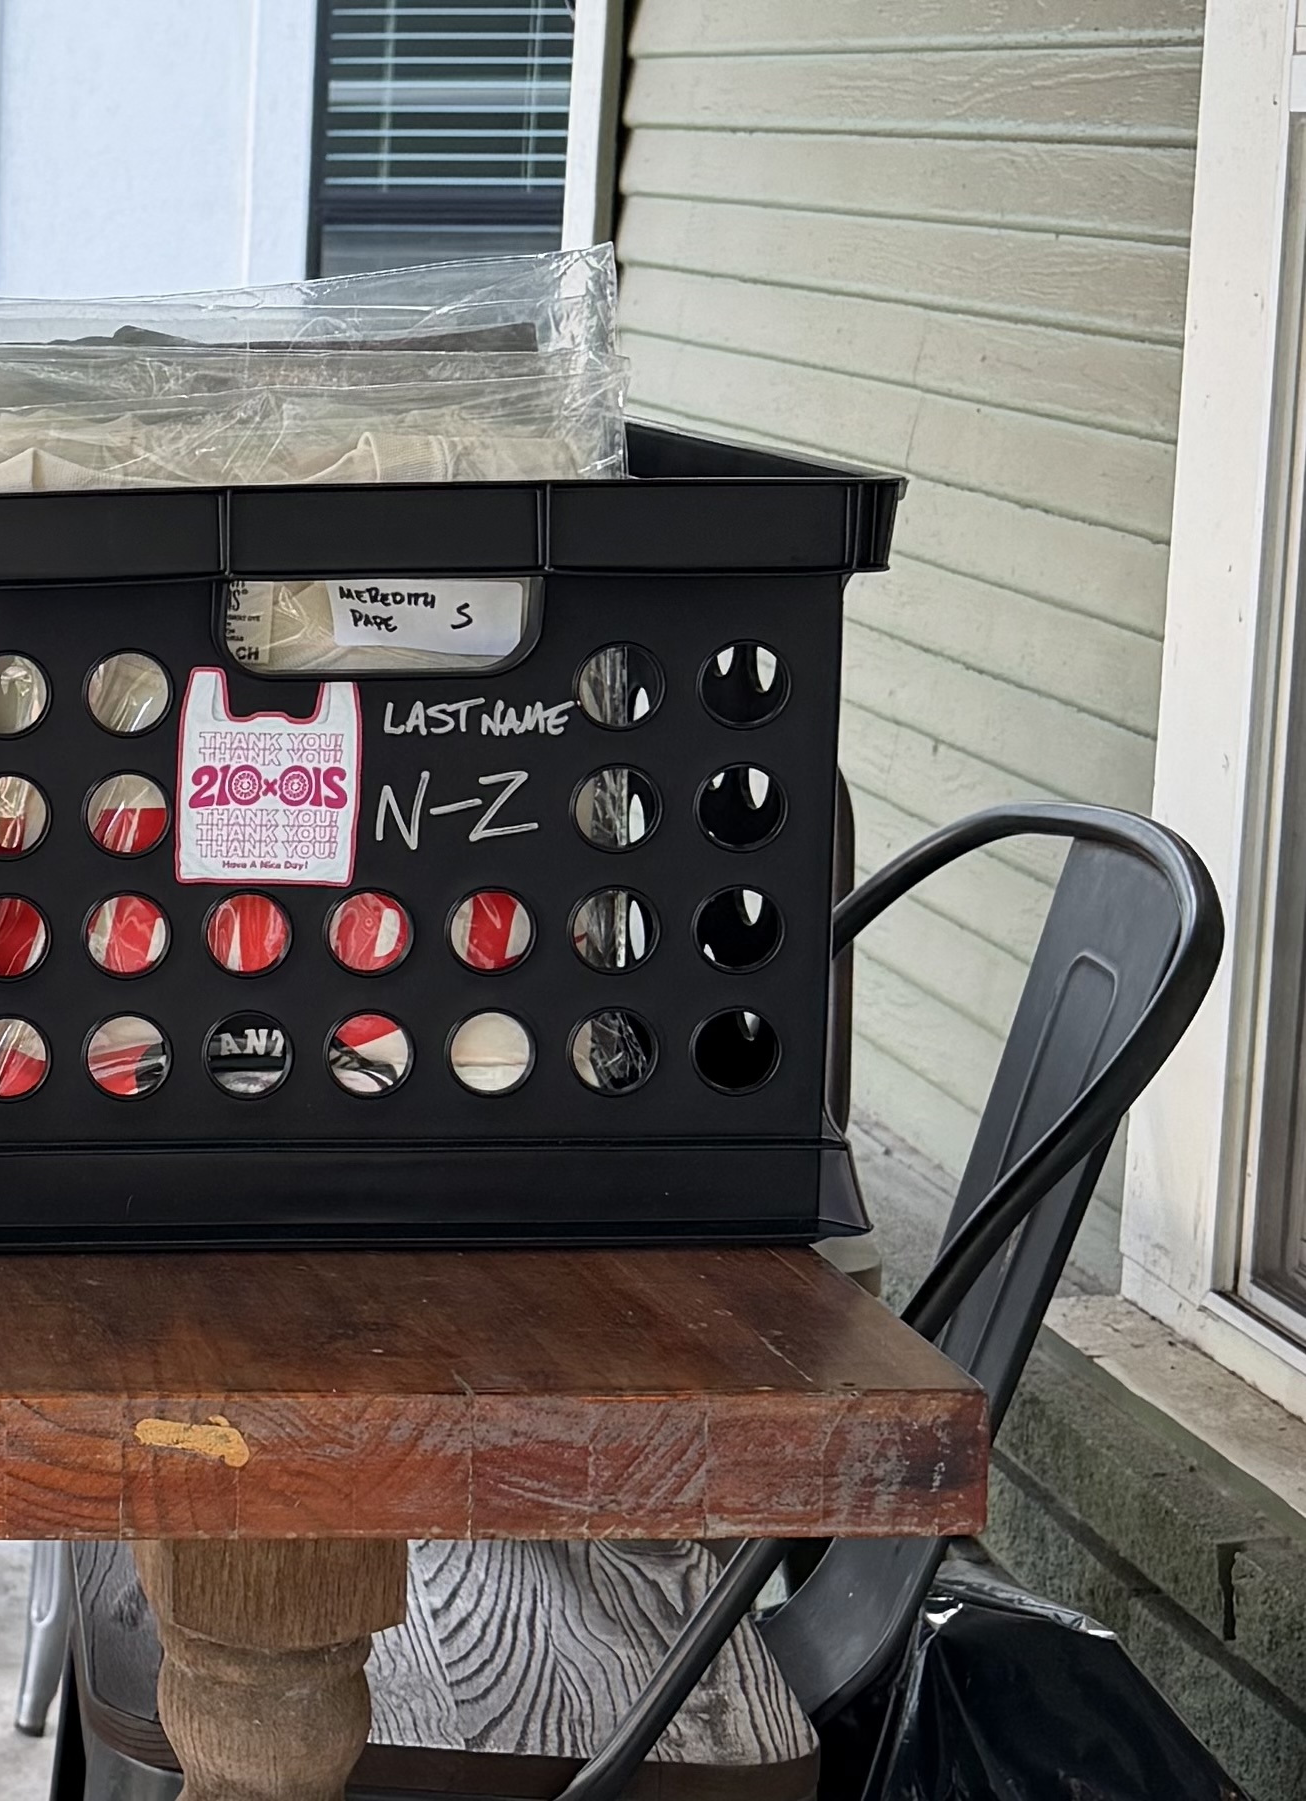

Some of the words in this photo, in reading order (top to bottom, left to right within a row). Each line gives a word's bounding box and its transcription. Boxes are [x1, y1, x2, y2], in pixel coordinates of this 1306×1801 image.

[338, 586, 436, 609] MEREDITH
[450, 602, 474, 630] S
[383, 697, 485, 736] LAST
[481, 699, 575, 736] NAME
[199, 731, 282, 750] THANK
[287, 733, 344, 750] YOU!
[198, 747, 281, 766] THANK
[287, 748, 343, 764] YOU!
[197, 808, 278, 827] THANK
[282, 809, 338, 827] YOU!
[375, 770, 539, 850] N-Z
[196, 824, 278, 842] THANK
[281, 825, 339, 843] YOU!
[196, 839, 278, 858] THANK
[281, 840, 339, 859] YOU!
[222, 861, 247, 869] Have
[250, 861, 257, 869] A
[260, 861, 281, 869] Nice
[284, 861, 308, 871] Day!
